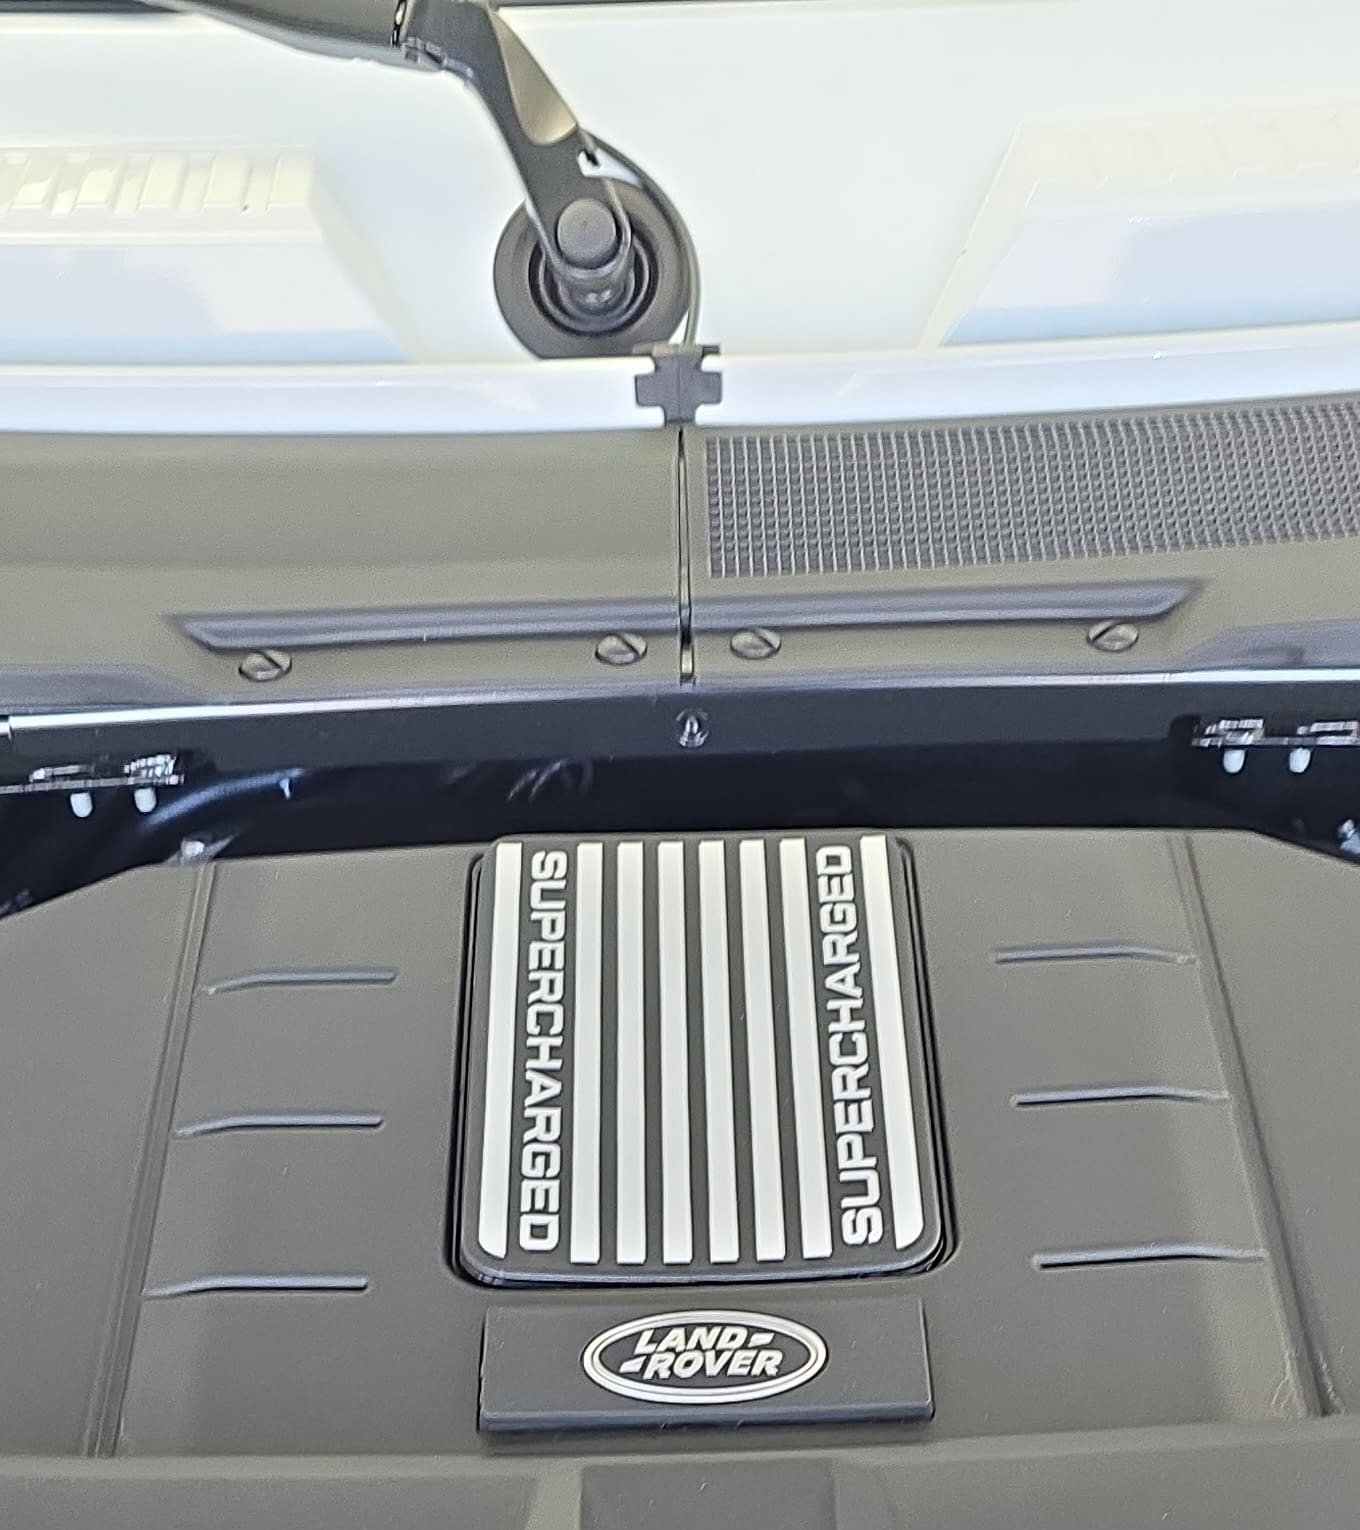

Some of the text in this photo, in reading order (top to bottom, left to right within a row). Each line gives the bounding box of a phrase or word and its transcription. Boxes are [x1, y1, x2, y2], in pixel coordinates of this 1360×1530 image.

[518, 849, 567, 1251] SUPERCHARGED
[815, 844, 883, 1246] SUPERCHARGED
[633, 1326, 752, 1355] LAND
[642, 1348, 783, 1380] ROVER
